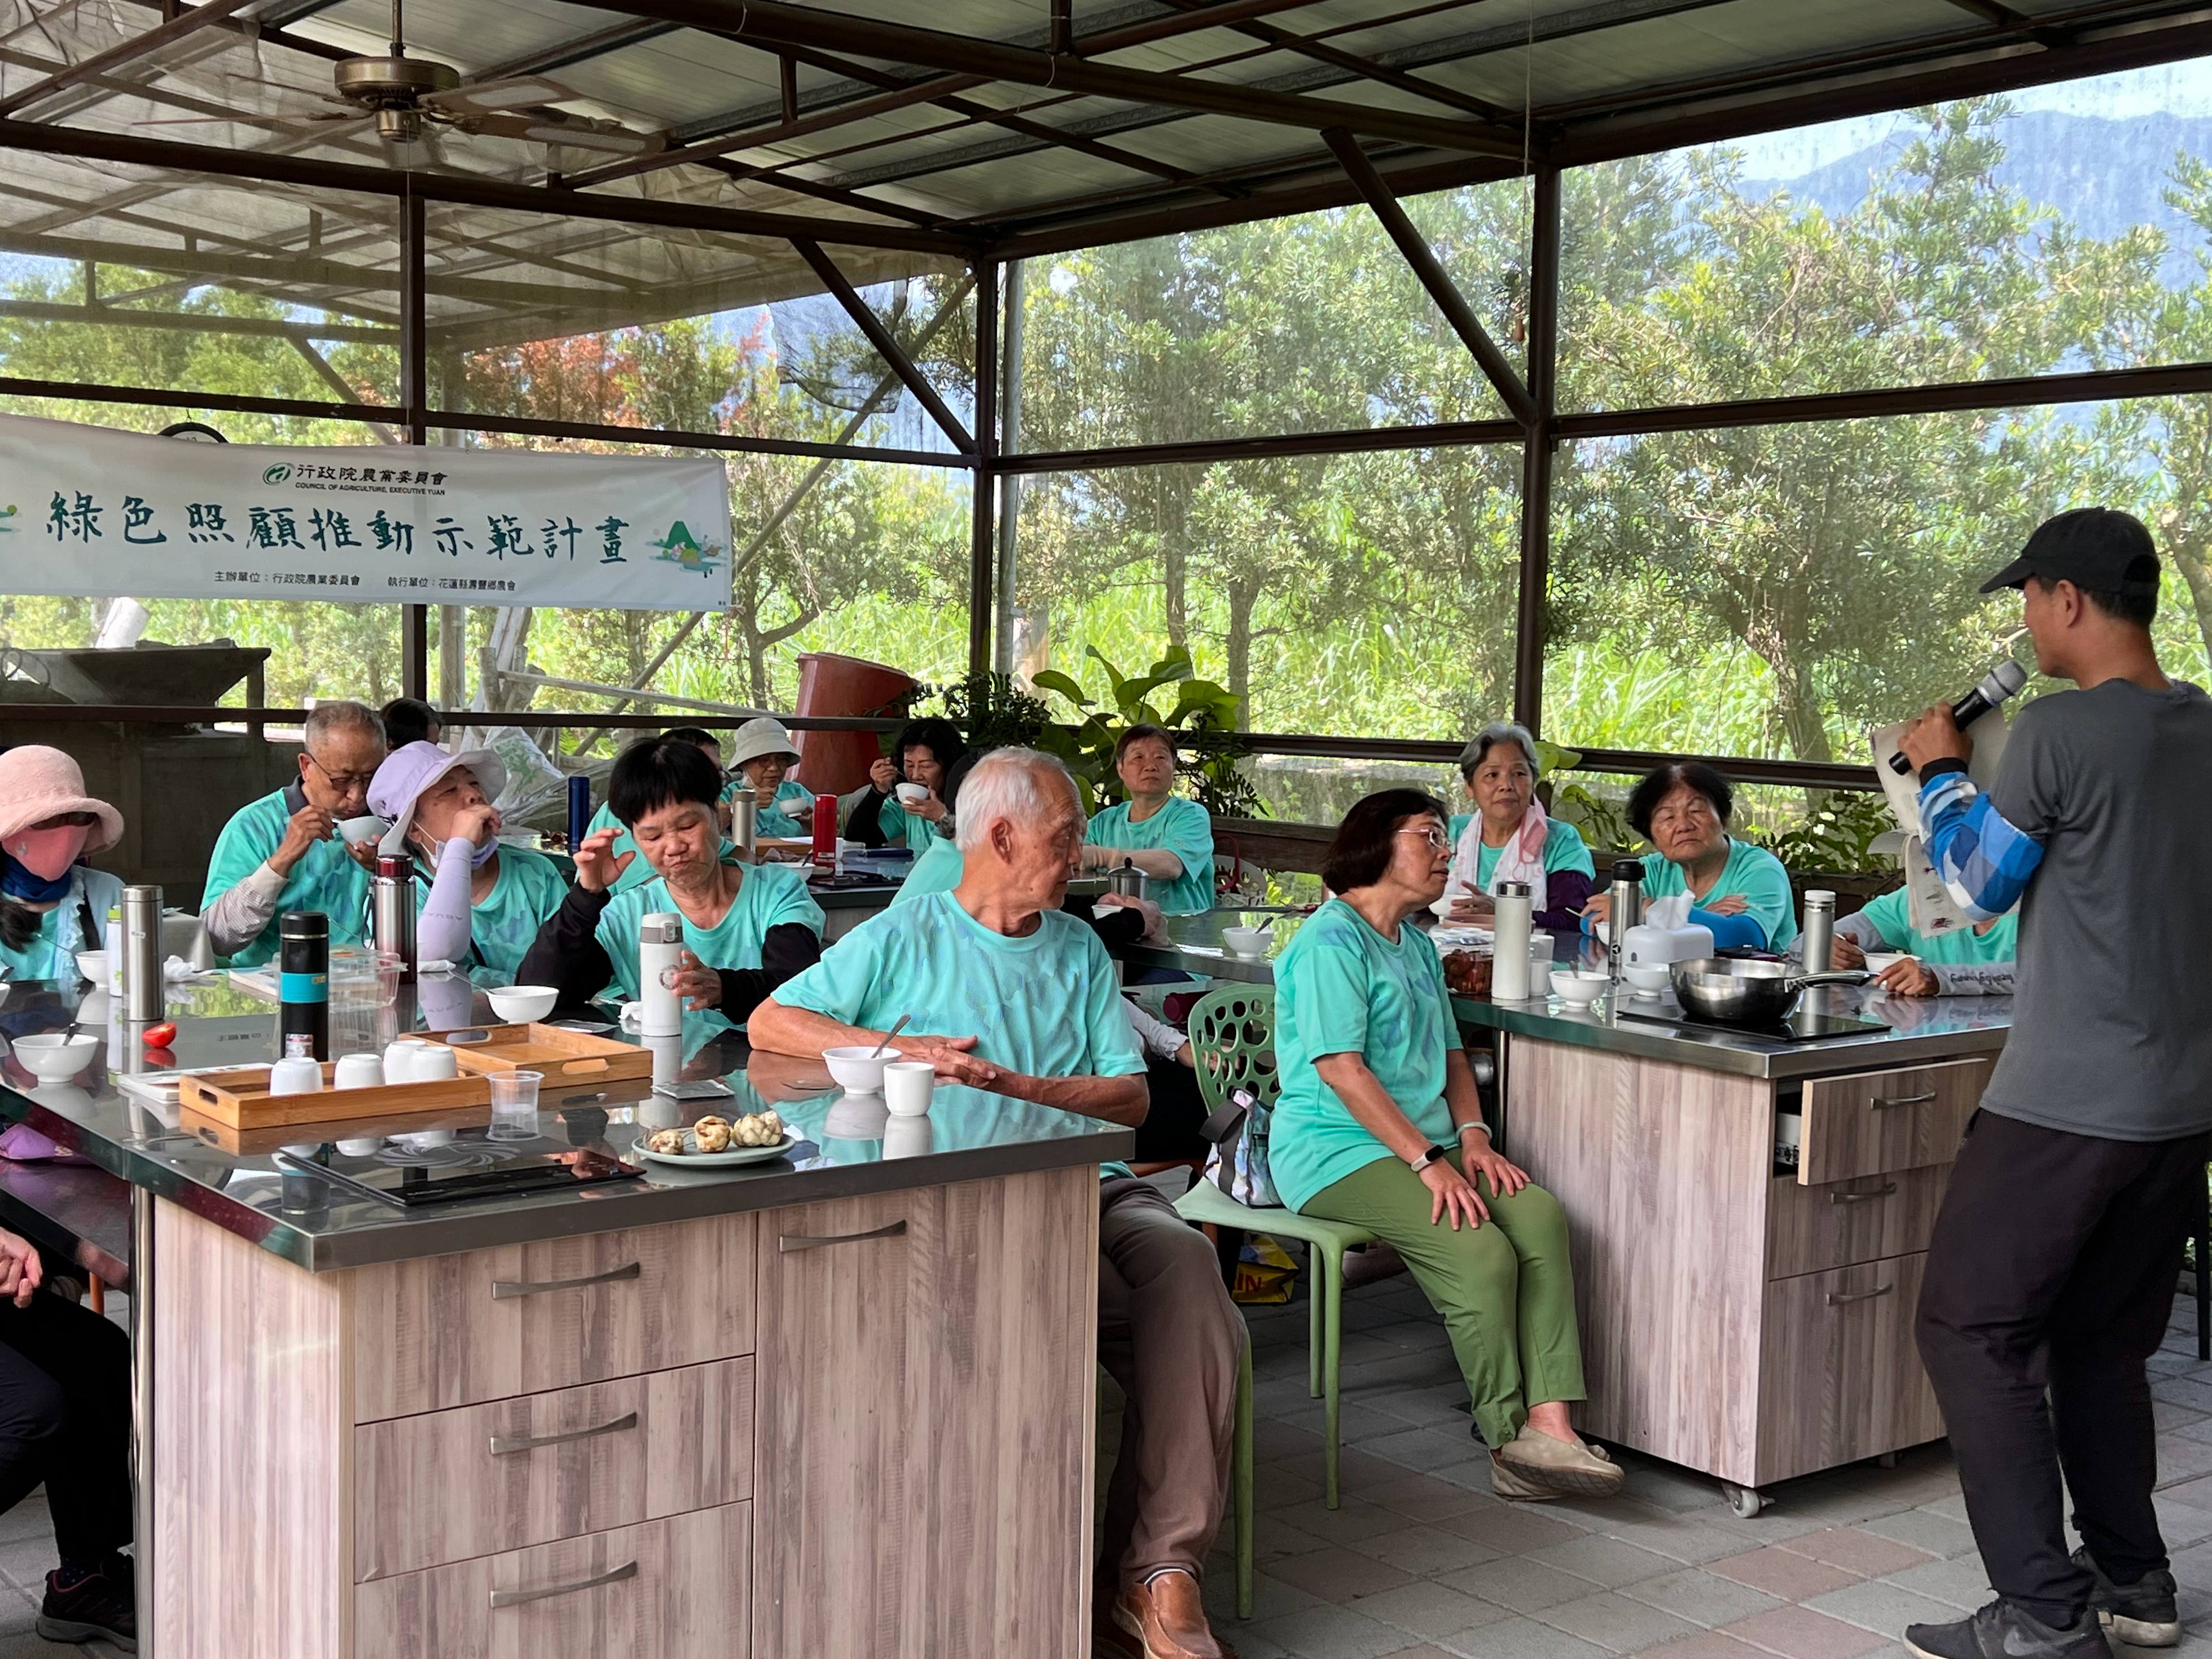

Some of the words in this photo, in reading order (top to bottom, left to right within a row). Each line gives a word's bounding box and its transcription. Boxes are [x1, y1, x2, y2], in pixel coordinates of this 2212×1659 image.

[296, 464, 448, 485] 行政院農業委員會
[389, 486, 425, 495] EXECUTIVE
[46, 490, 630, 564] 綠色照顧推動示範計畫
[1236, 1272, 1262, 1292] IN
